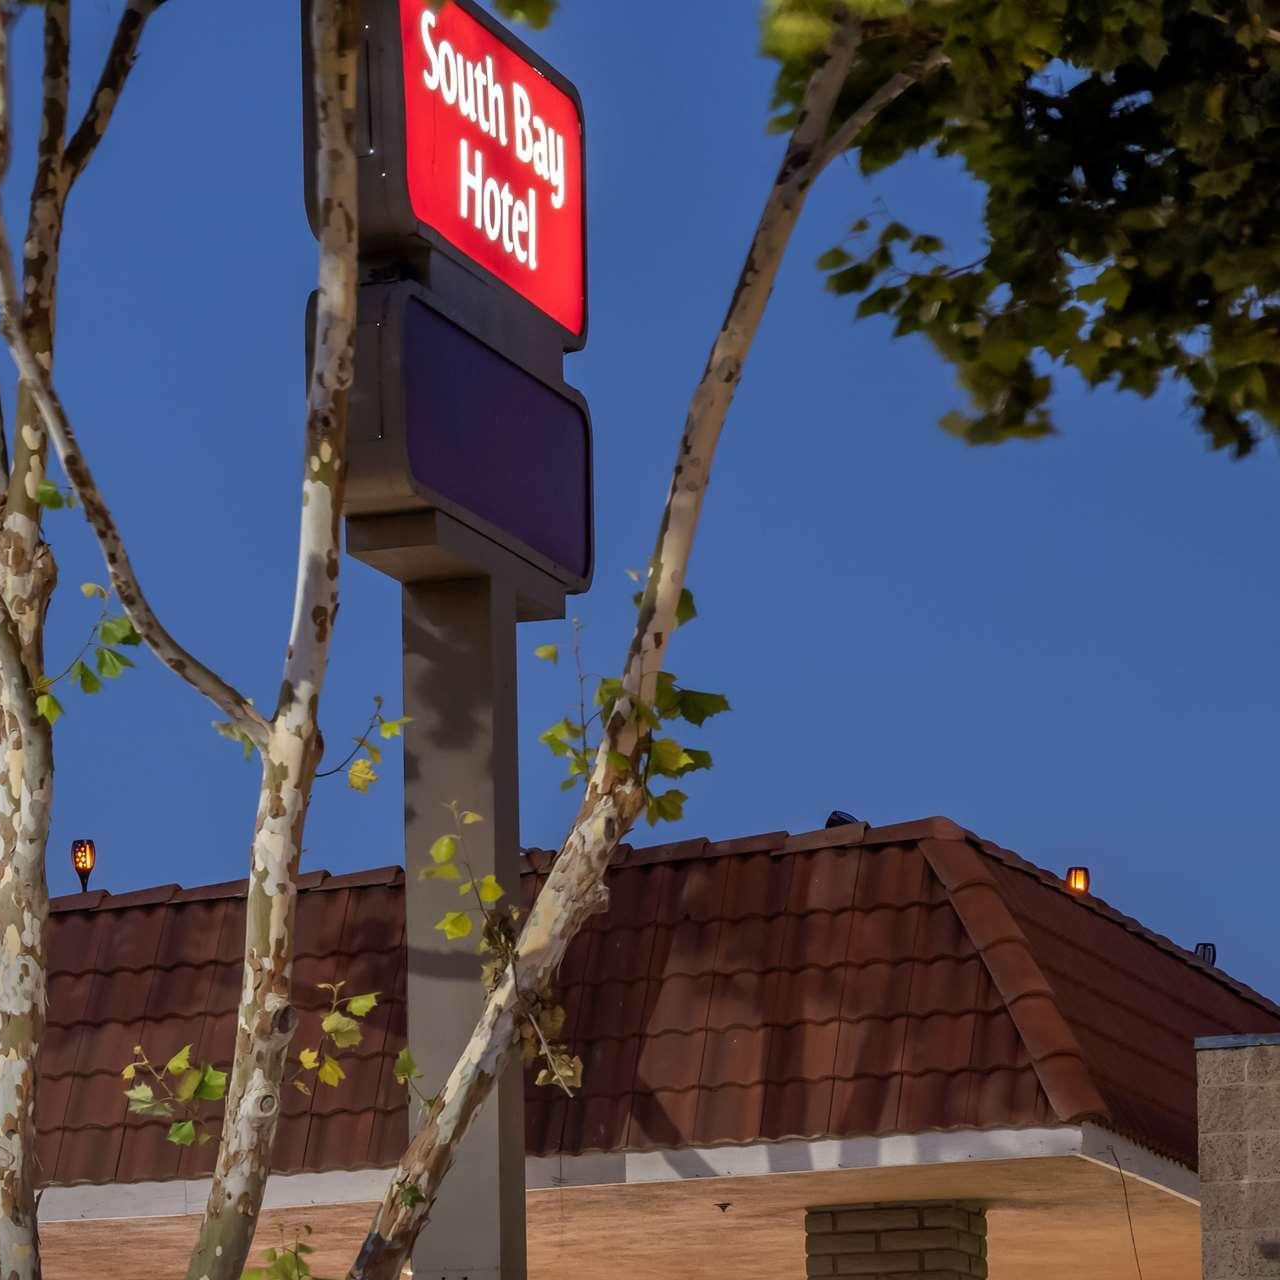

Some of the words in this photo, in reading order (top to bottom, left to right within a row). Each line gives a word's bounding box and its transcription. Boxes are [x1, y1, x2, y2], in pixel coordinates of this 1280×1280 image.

[421, 10, 507, 146] South
[513, 82, 565, 209] Bay
[460, 139, 537, 270] Hotel
